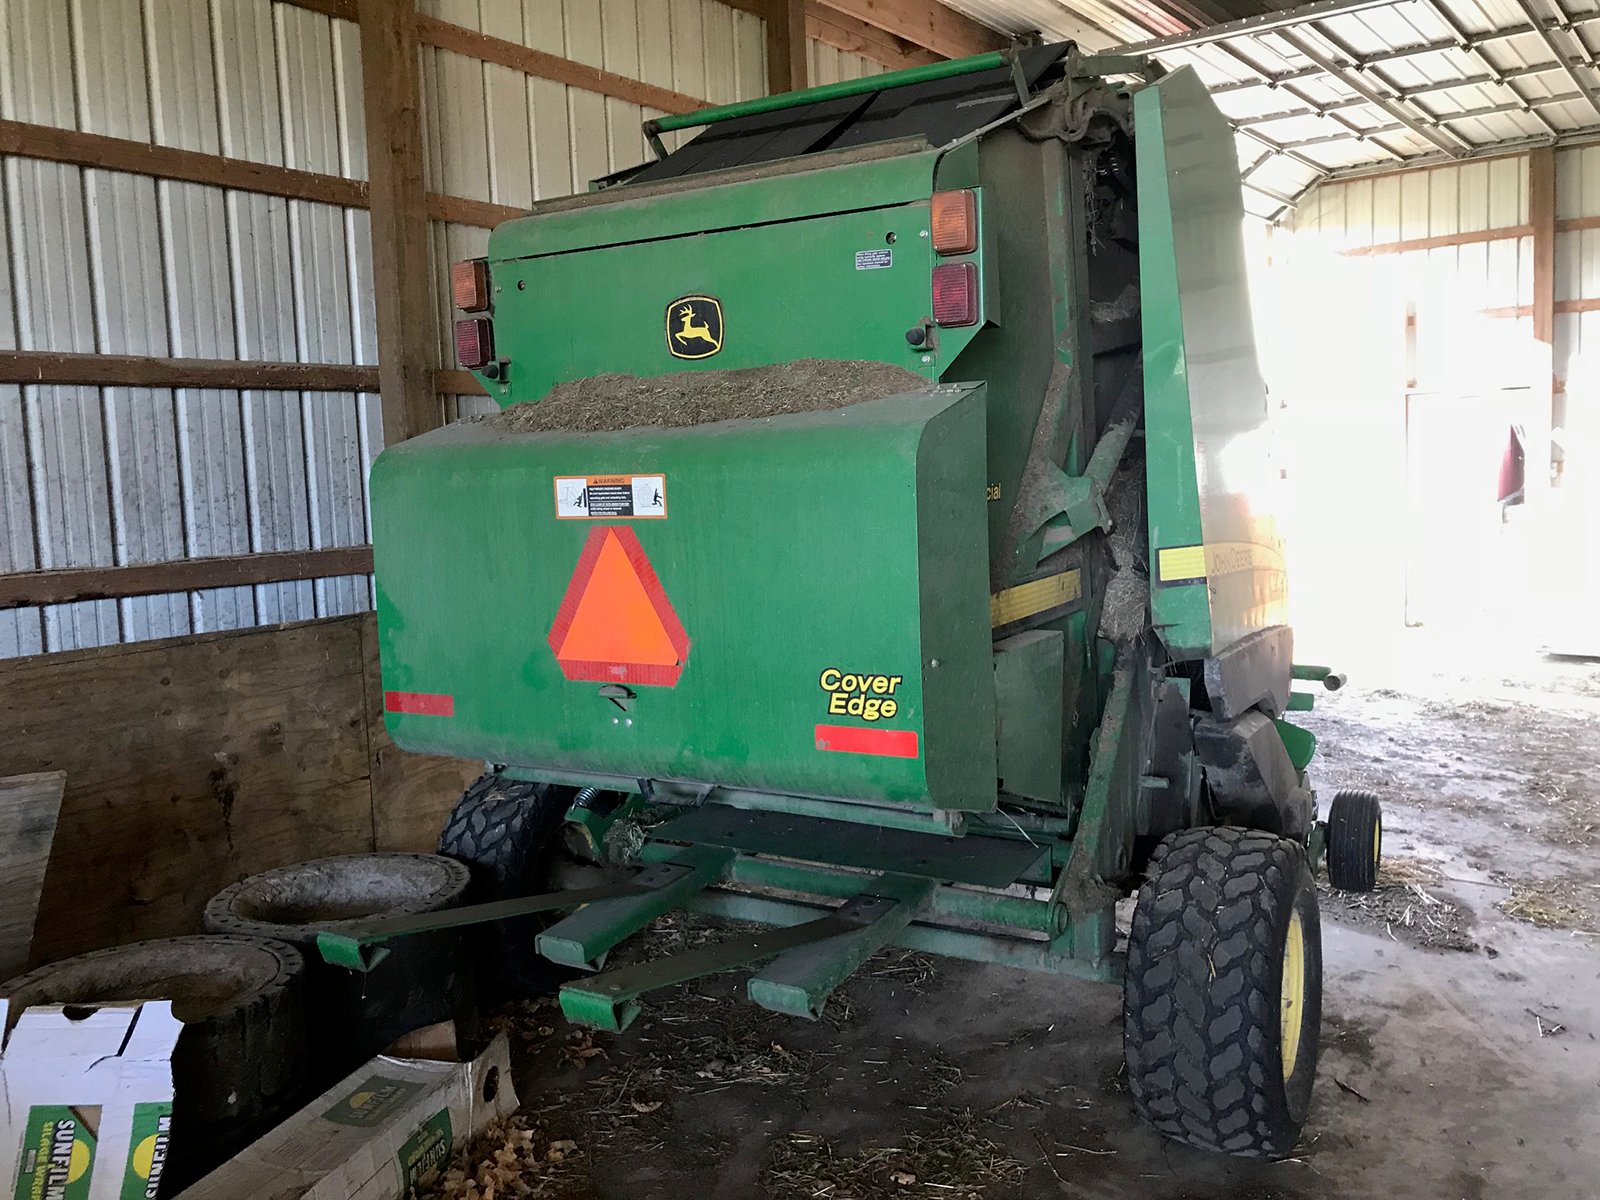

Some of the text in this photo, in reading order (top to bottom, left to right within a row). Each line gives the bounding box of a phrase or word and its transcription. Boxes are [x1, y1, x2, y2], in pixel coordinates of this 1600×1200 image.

[987, 482, 1002, 501] cial
[819, 668, 903, 695] Cover
[828, 692, 898, 722] Edge
[37, 1121, 54, 1163] SILAGE
[45, 1119, 76, 1200] SUNFILM
